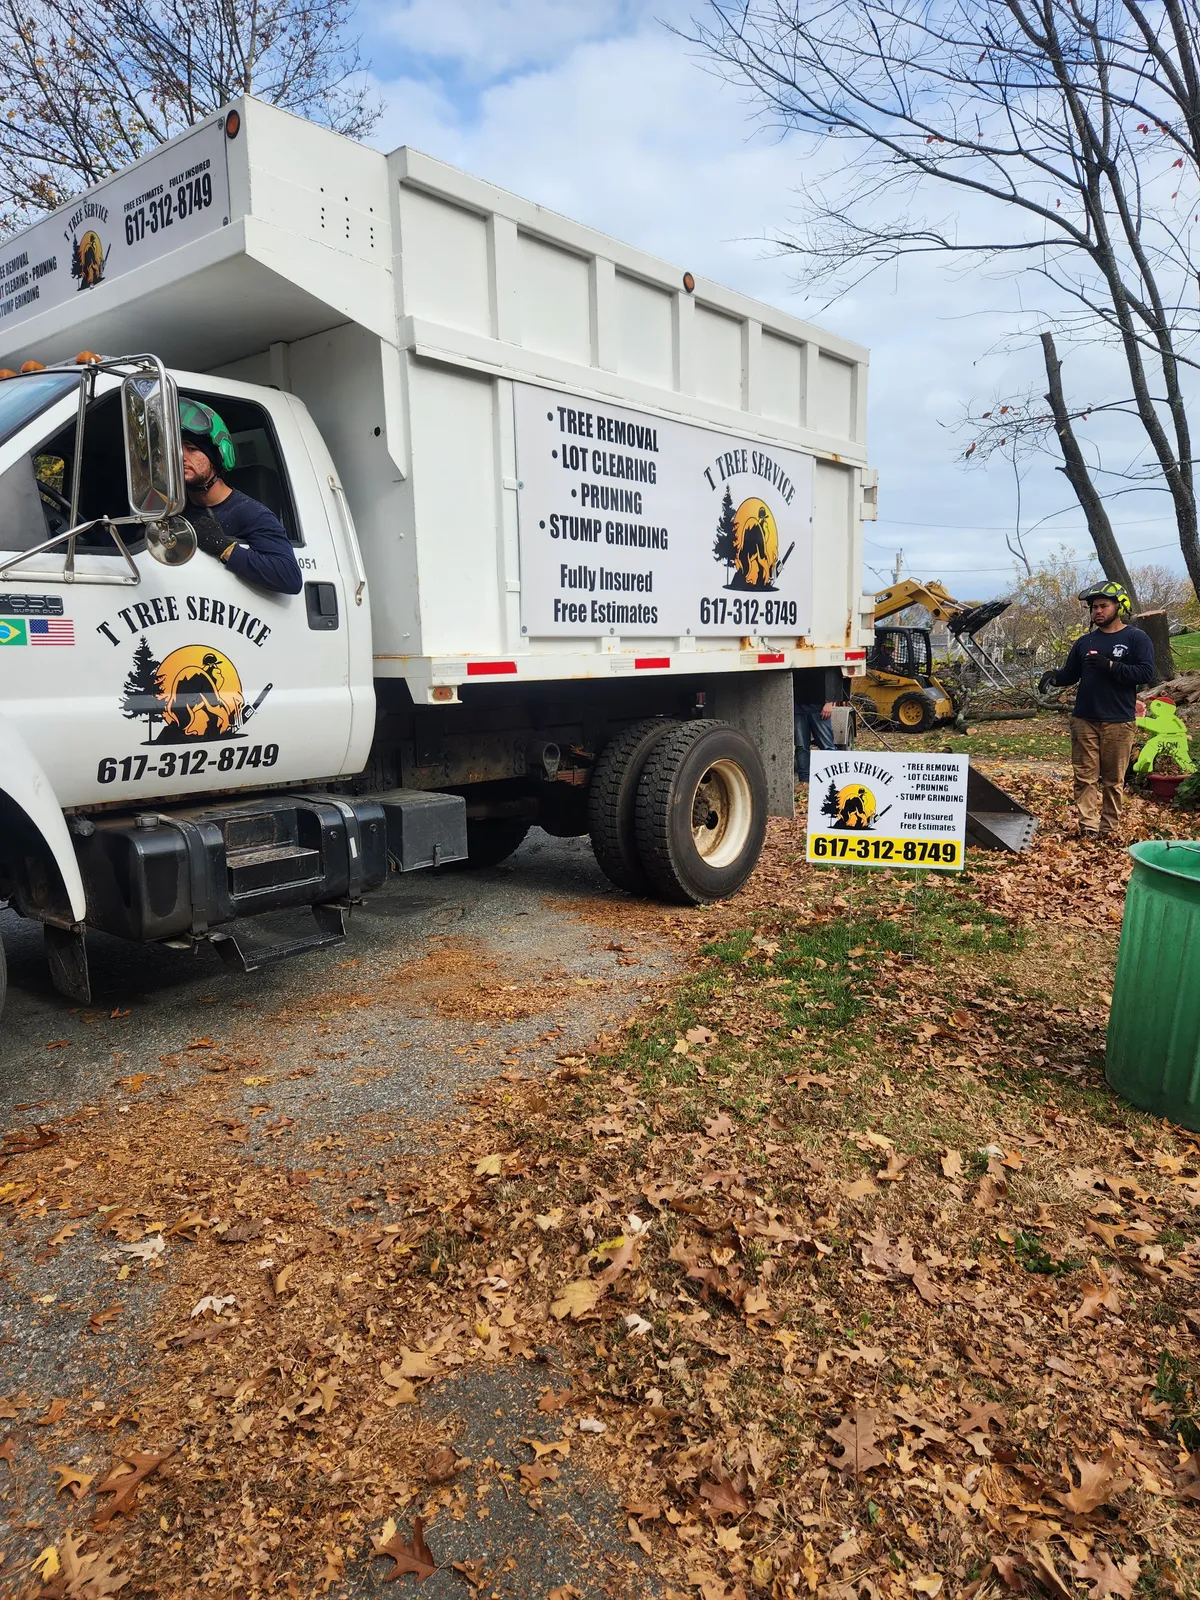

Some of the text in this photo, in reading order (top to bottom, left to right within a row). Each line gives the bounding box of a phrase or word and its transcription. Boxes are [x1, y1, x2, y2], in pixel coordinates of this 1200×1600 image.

[124, 158, 210, 213] FREE ESTIMATES FULLY INSURED
[64, 203, 108, 242] T TREE SERVICE
[125, 172, 212, 246] 617-312-8749
[5, 271, 29, 296] CLEARING
[32, 256, 57, 281] PRUNING
[6, 251, 29, 277] REMOVAL
[15, 286, 40, 310] GRINDING
[557, 406, 659, 453] TREE REMOVAL
[562, 443, 656, 485] LOT CLEARING
[703, 448, 796, 506] T TREE SERVICE
[581, 482, 642, 515] PRUNING
[549, 513, 668, 550] STUMP GRINDING
[560, 564, 653, 593] Fully Insured
[96, 596, 272, 648] T TREE SERVICE
[553, 598, 658, 624] Free Estimates
[700, 597, 798, 626] 617-312-8749
[96, 743, 280, 784] 617-312-8749
[814, 761, 895, 786] T TREE SERVICE
[907, 763, 960, 772] TREE REMOVAL
[922, 774, 958, 782] CLEARING
[900, 793, 964, 802] STUMP GRINDING
[916, 784, 949, 792] PRUNING
[900, 822, 956, 832] Free Estimates
[904, 812, 954, 822] Fully Insured
[814, 837, 956, 863] 617-312-8749
